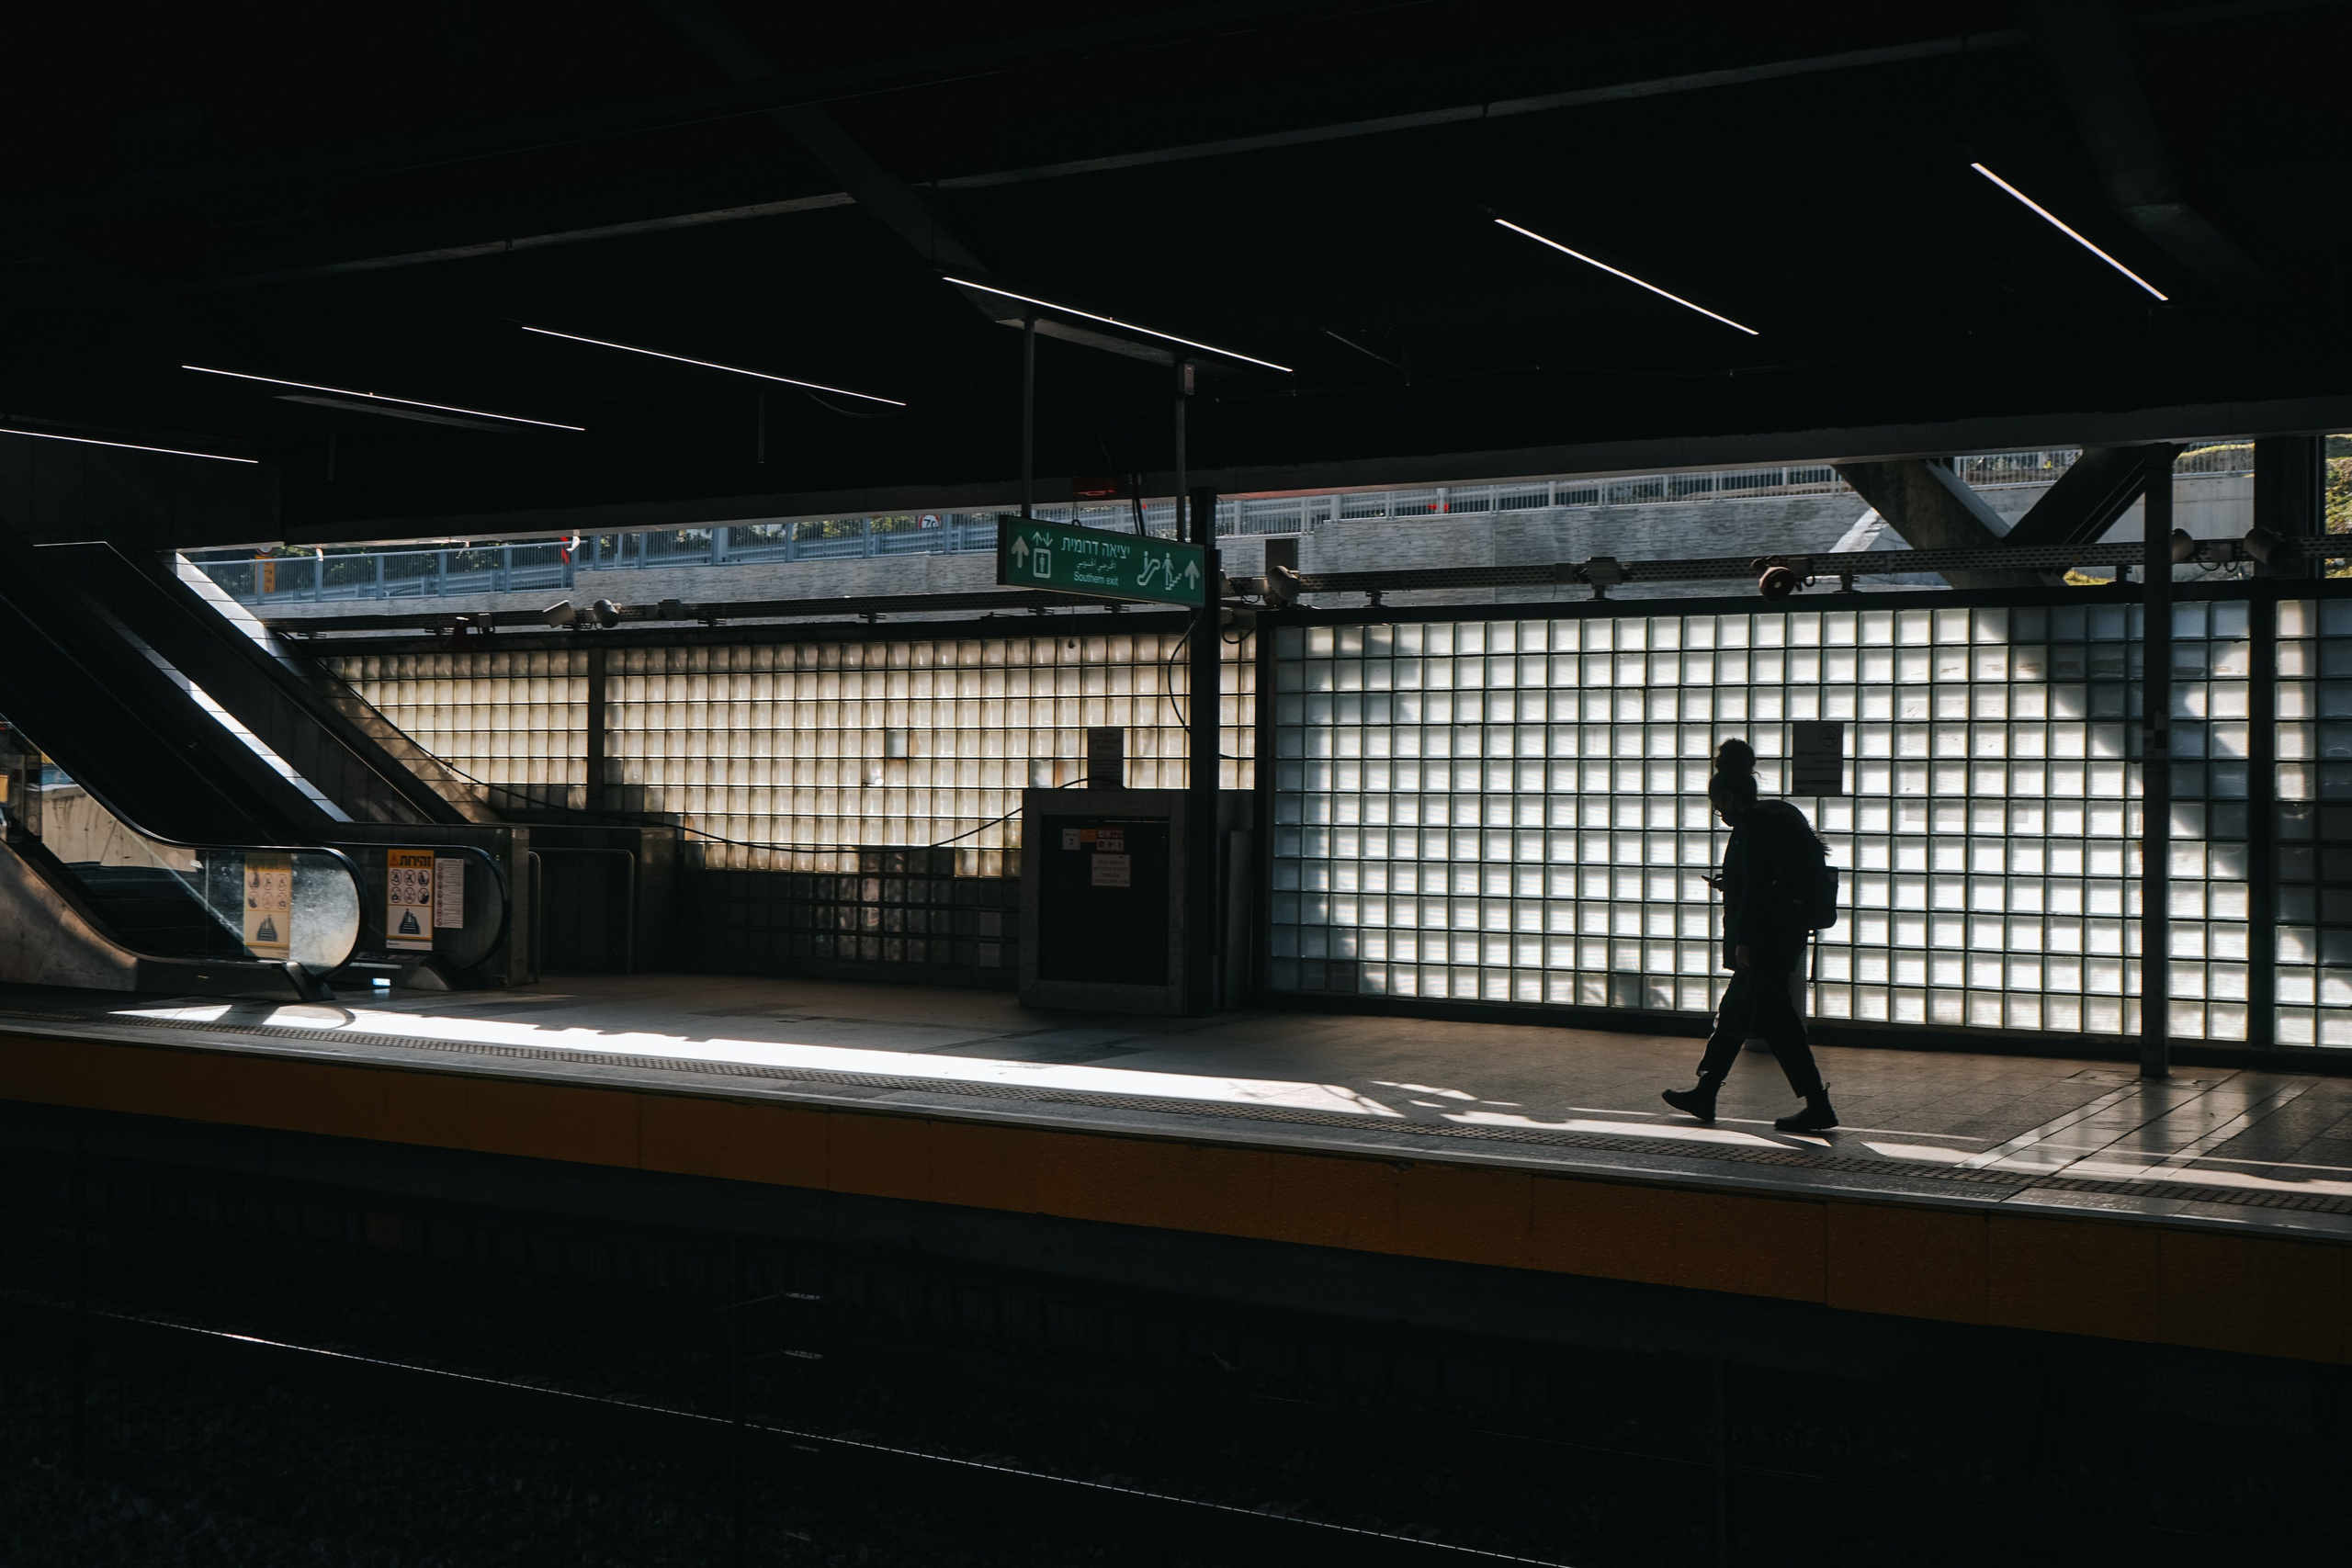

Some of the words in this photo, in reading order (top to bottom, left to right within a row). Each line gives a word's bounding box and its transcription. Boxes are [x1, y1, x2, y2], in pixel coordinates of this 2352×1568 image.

[1061, 536, 1099, 555] דרומית
[1102, 542, 1130, 558] יציאה
[1073, 570, 1105, 584] Southern
[1105, 576, 1119, 586] exit
[399, 855, 432, 867] זהירות
